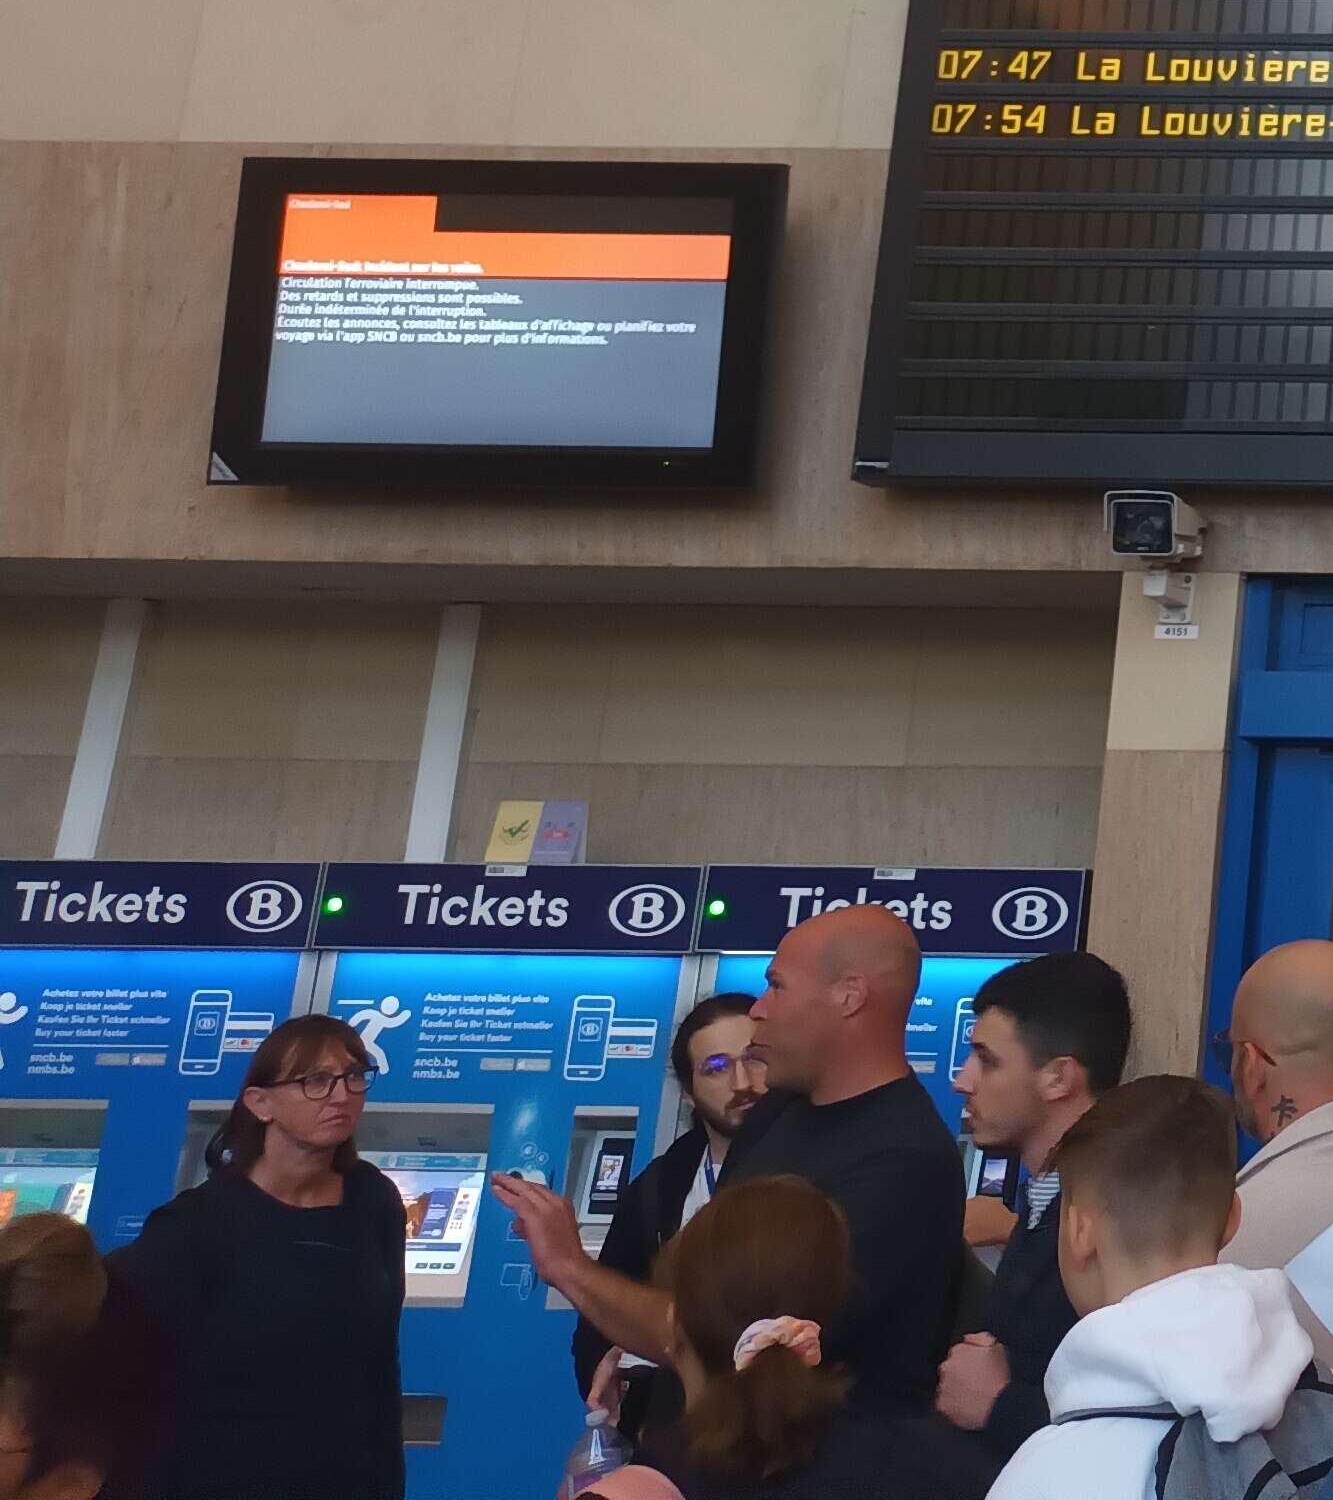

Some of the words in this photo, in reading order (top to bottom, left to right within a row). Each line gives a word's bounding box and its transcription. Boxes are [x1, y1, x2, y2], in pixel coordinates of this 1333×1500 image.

[938, 50, 1051, 80] 07:47
[1076, 52, 1121, 82] La
[930, 103, 1046, 135] 07:54
[1070, 105, 1115, 136] La
[281, 278, 342, 289] Circulation
[280, 291, 301, 301] Des
[304, 291, 344, 302] retards
[347, 293, 358, 302] et
[361, 293, 436, 304] suppressions
[438, 294, 464, 304] sont
[392, 306, 406, 315] de
[324, 317, 340, 328] les
[318, 331, 334, 342] via
[367, 331, 397, 342] SNCB
[400, 333, 416, 343] ou
[464, 334, 491, 345] pour
[15, 881, 188, 925] Tickets
[397, 884, 570, 928] Tickets
